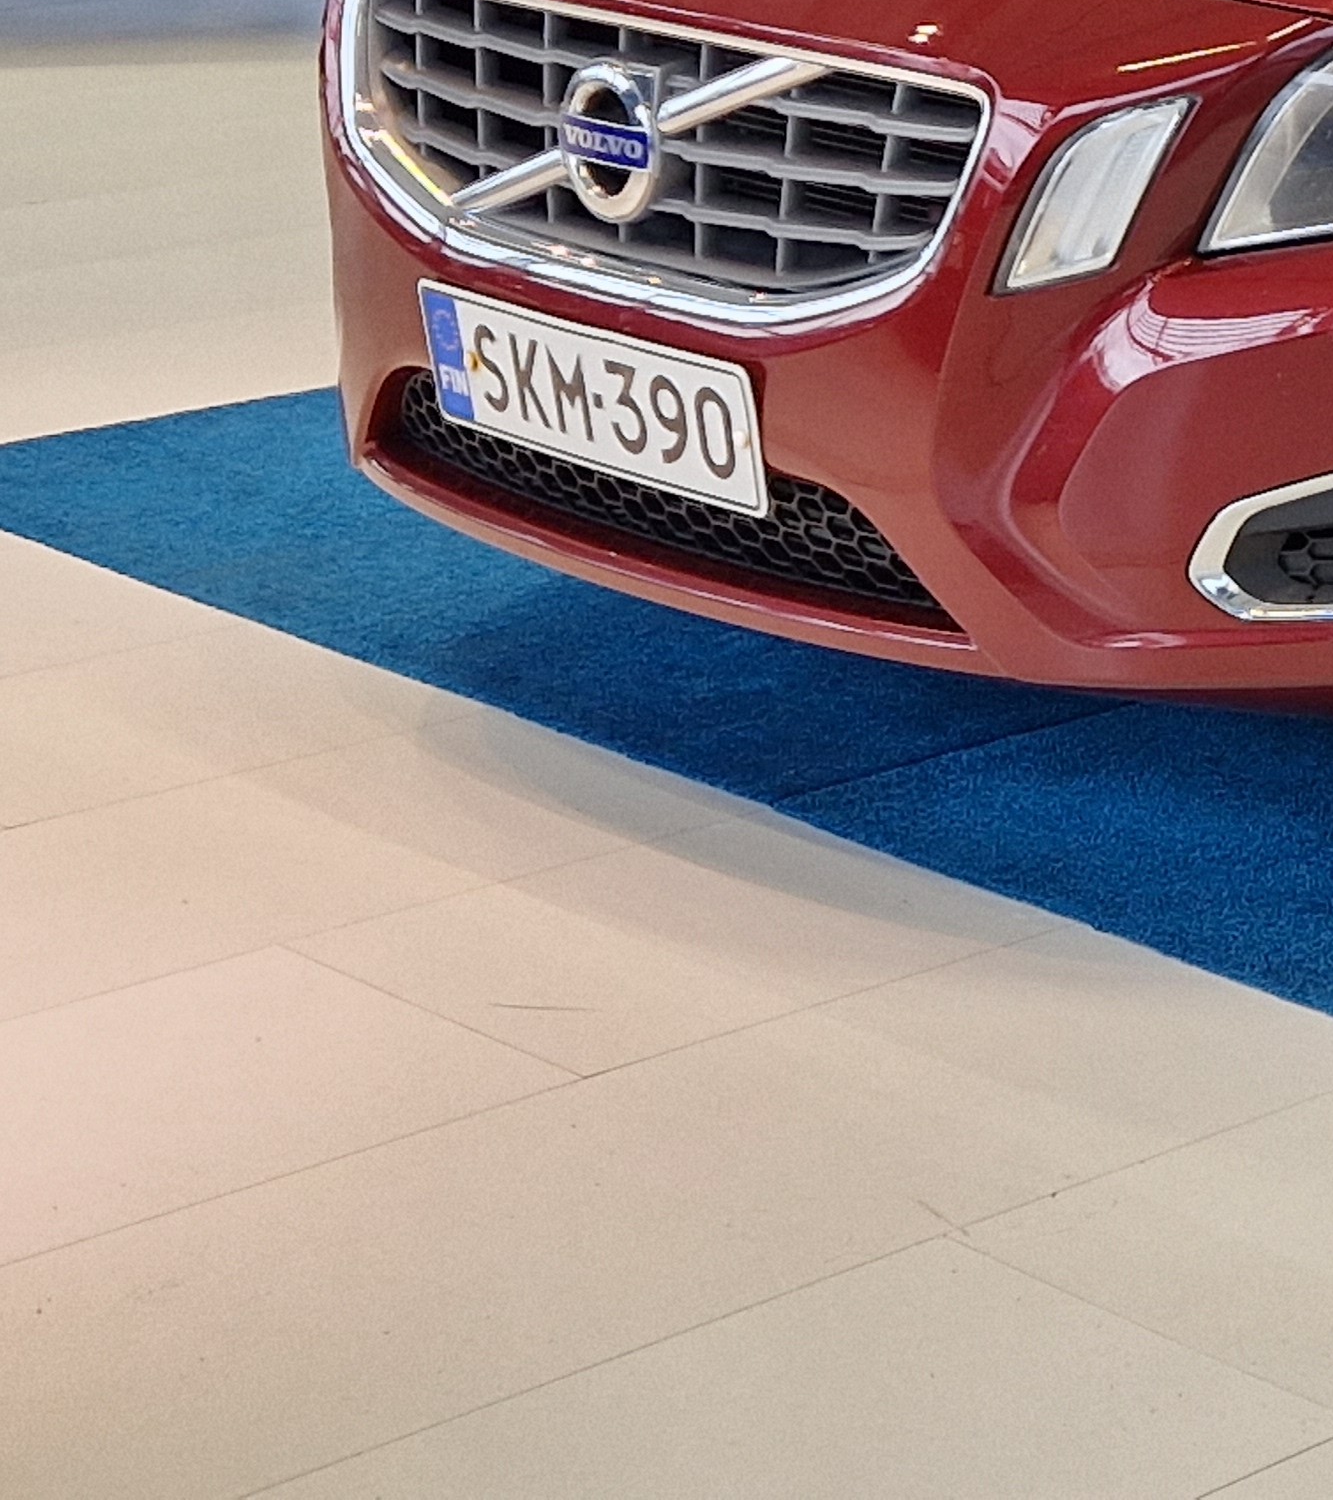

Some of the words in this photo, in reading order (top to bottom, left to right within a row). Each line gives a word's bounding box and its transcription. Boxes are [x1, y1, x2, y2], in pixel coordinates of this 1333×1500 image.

[562, 122, 644, 159] VOLVO
[440, 363, 470, 397] FIN
[473, 324, 737, 480] SKM-390
